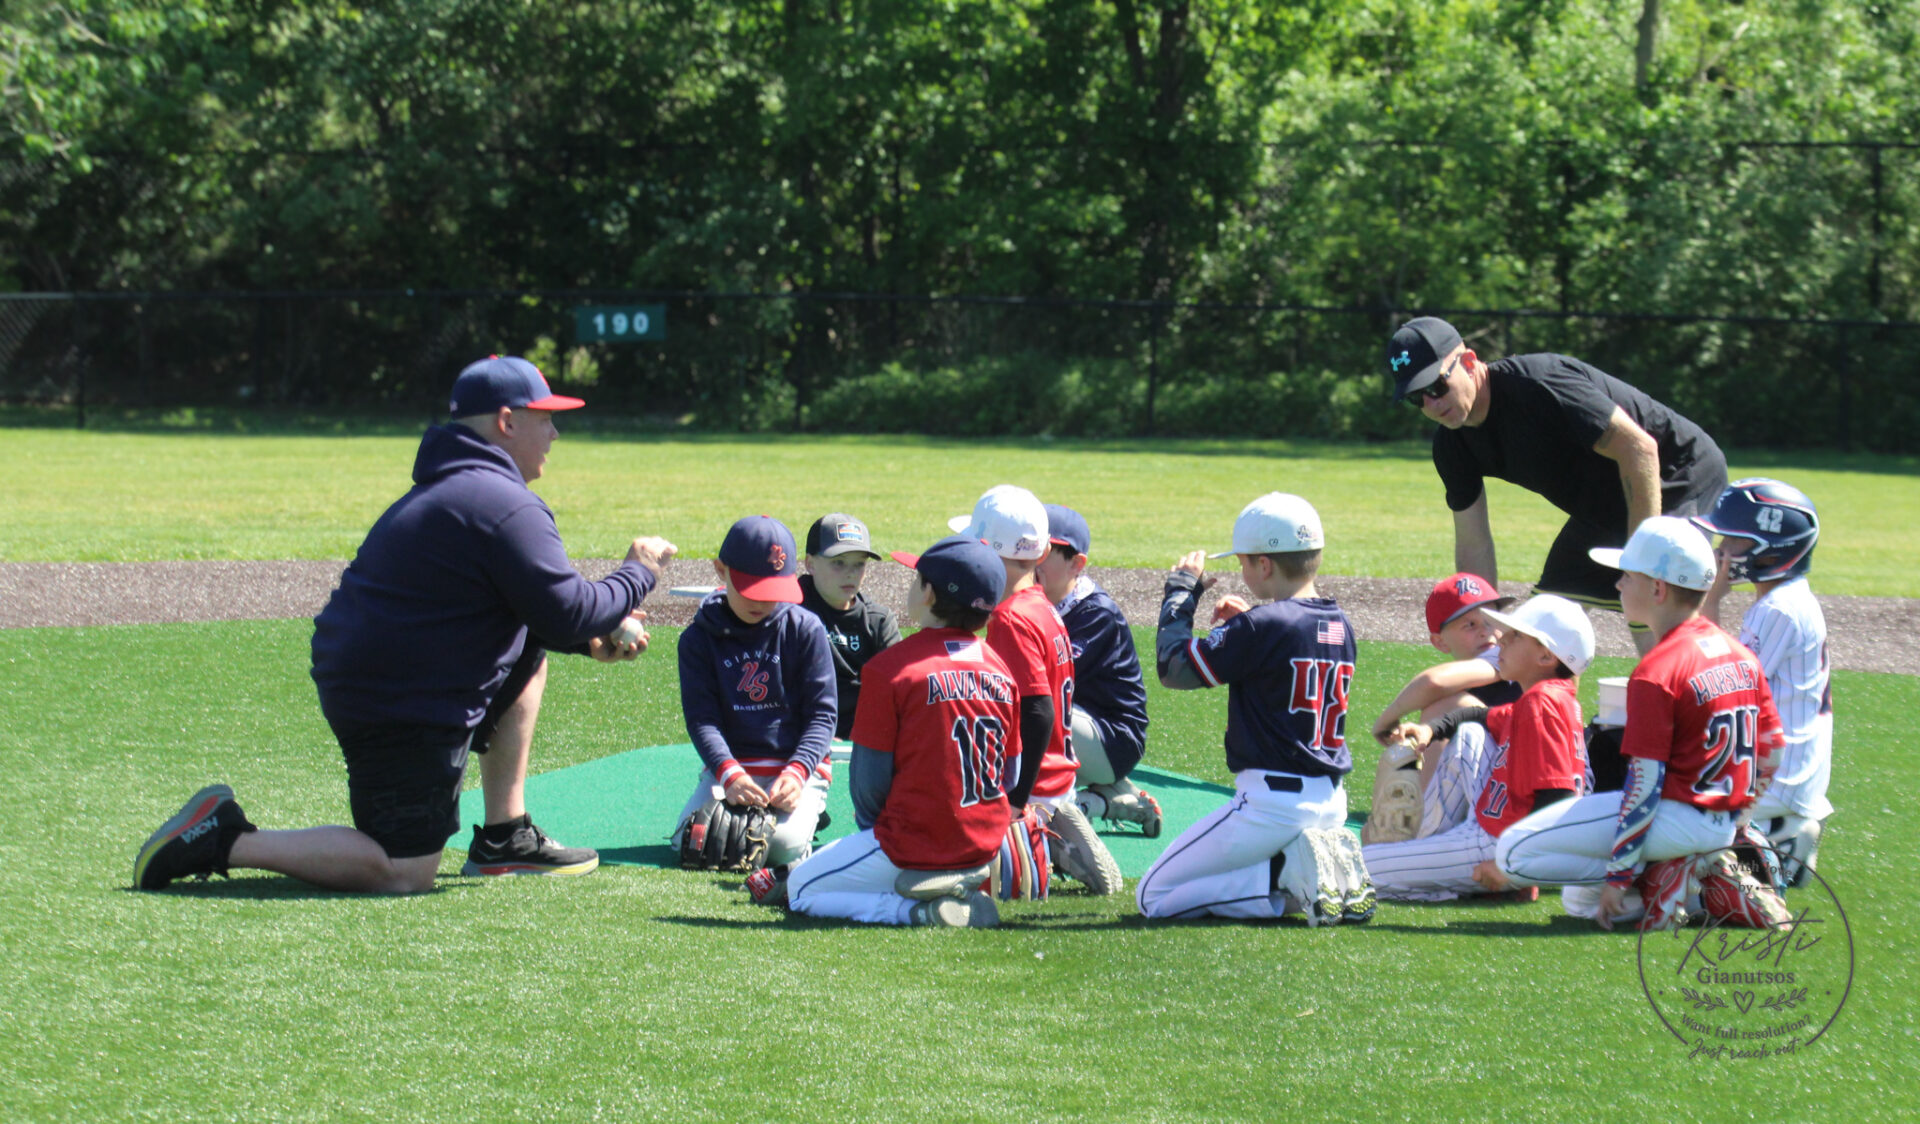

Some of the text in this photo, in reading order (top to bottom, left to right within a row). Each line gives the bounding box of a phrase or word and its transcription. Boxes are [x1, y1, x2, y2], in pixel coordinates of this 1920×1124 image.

[592, 311, 650, 335] 190
[1756, 506, 1783, 534] 42
[723, 650, 780, 668] GIANTS
[926, 670, 1014, 705] ALVAREZ
[1689, 660, 1760, 706] HORSLEY
[1288, 658, 1355, 751] 48
[951, 715, 1005, 808] 10
[1690, 704, 1761, 797] 24
[181, 815, 219, 844] HOKA
